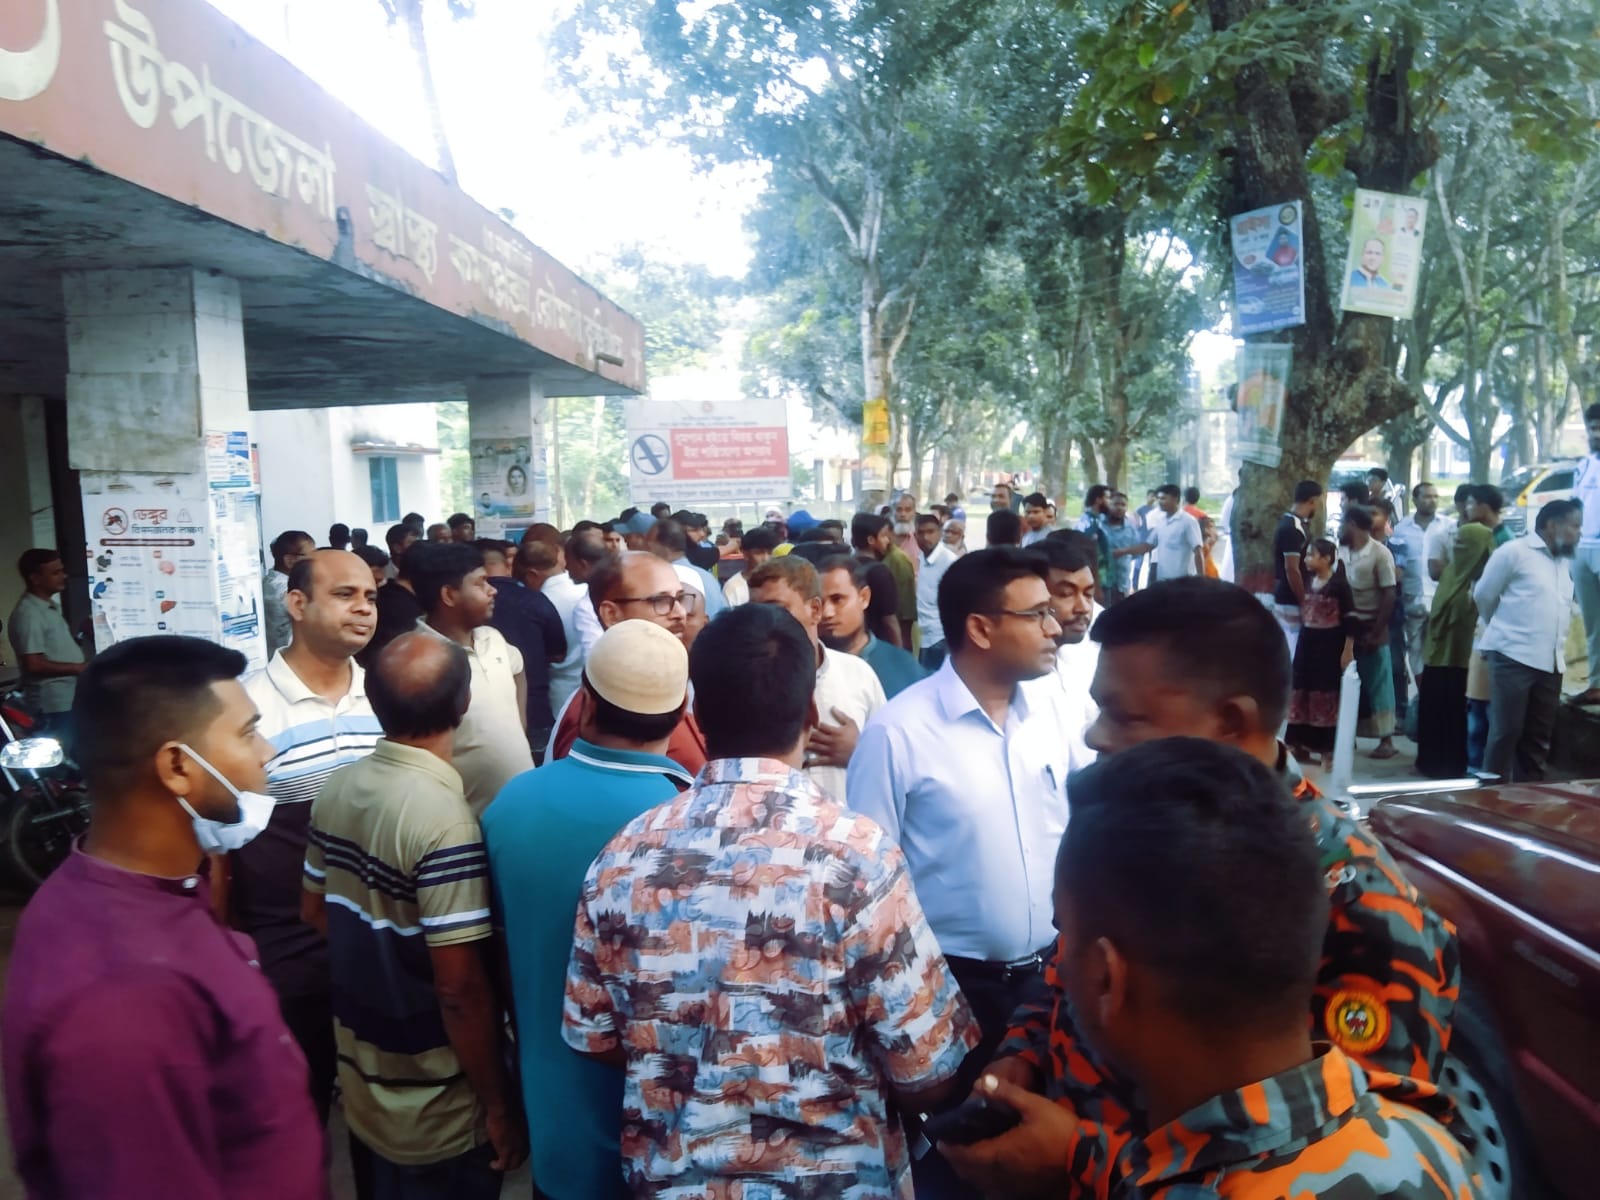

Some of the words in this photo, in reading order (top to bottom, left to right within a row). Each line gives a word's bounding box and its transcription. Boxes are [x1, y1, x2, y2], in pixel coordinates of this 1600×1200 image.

[103, 0, 337, 222] উপজেলা
[365, 182, 439, 284] স্বাস্থ্য
[132, 509, 168, 525] ডেঙ্গুর
